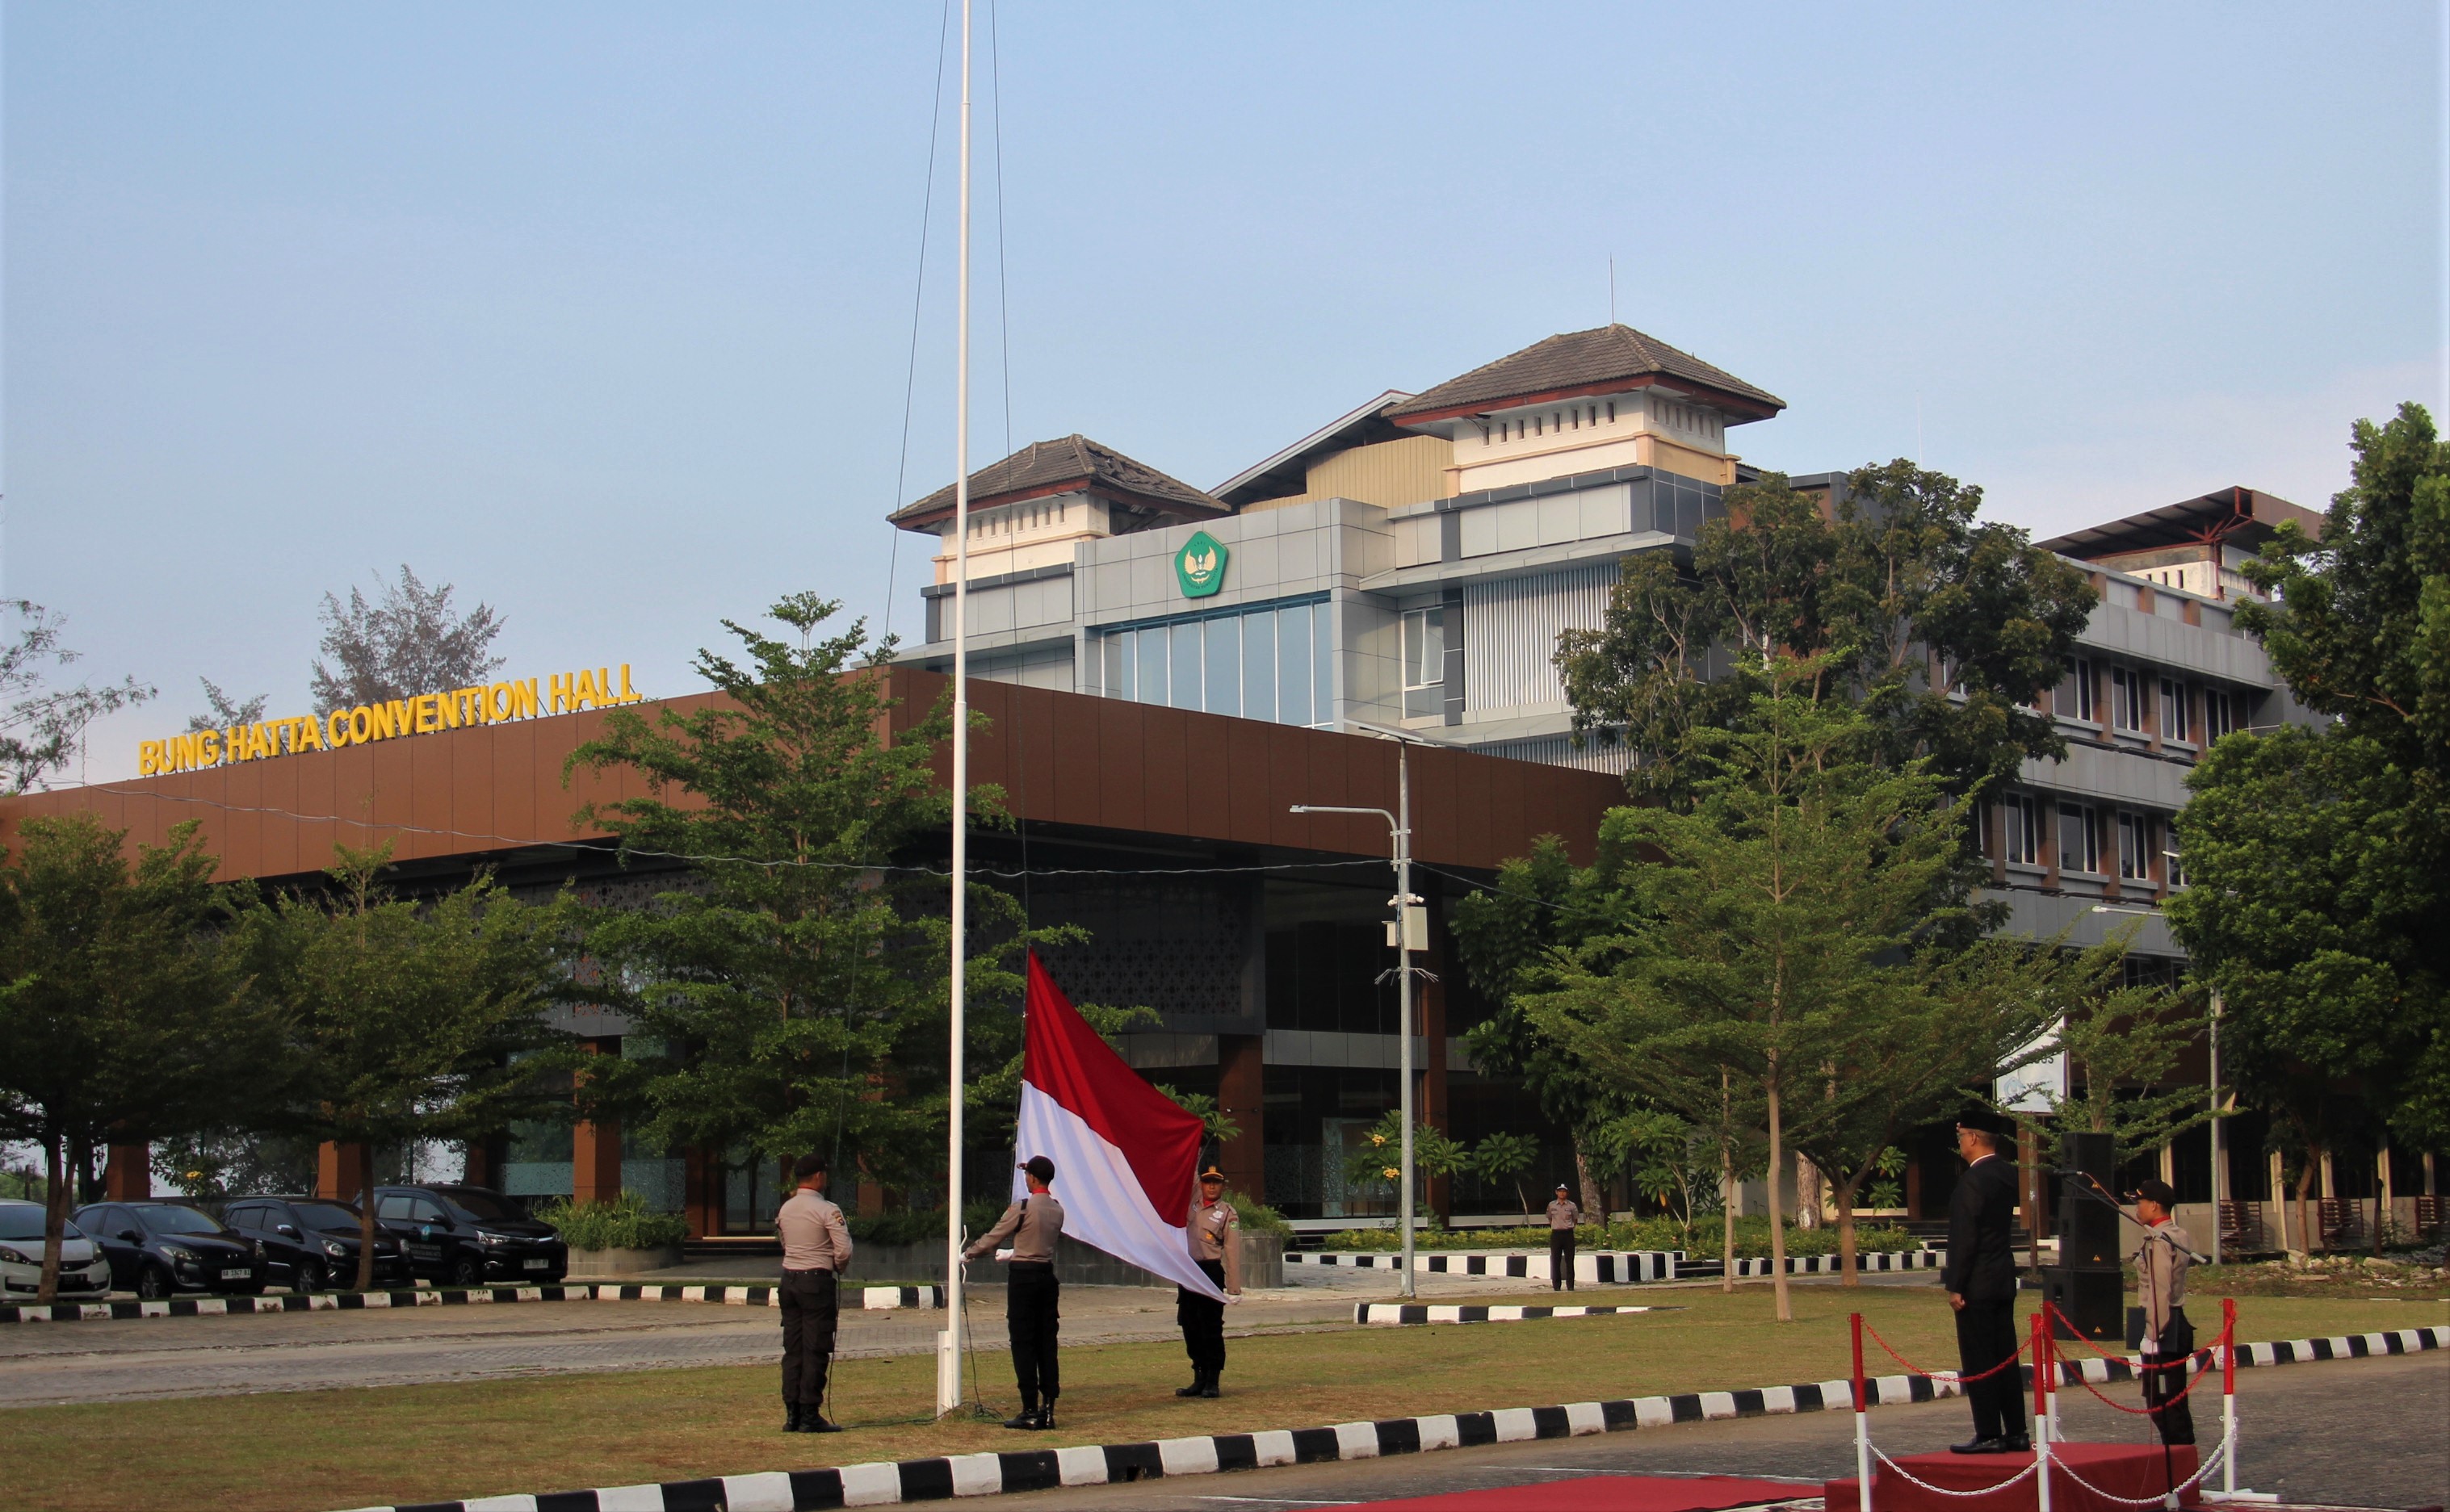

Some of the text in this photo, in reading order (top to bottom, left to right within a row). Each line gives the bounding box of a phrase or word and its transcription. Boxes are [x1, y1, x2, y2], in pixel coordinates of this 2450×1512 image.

[140, 664, 643, 776] BUNG HATTA CONVENTION HALL
